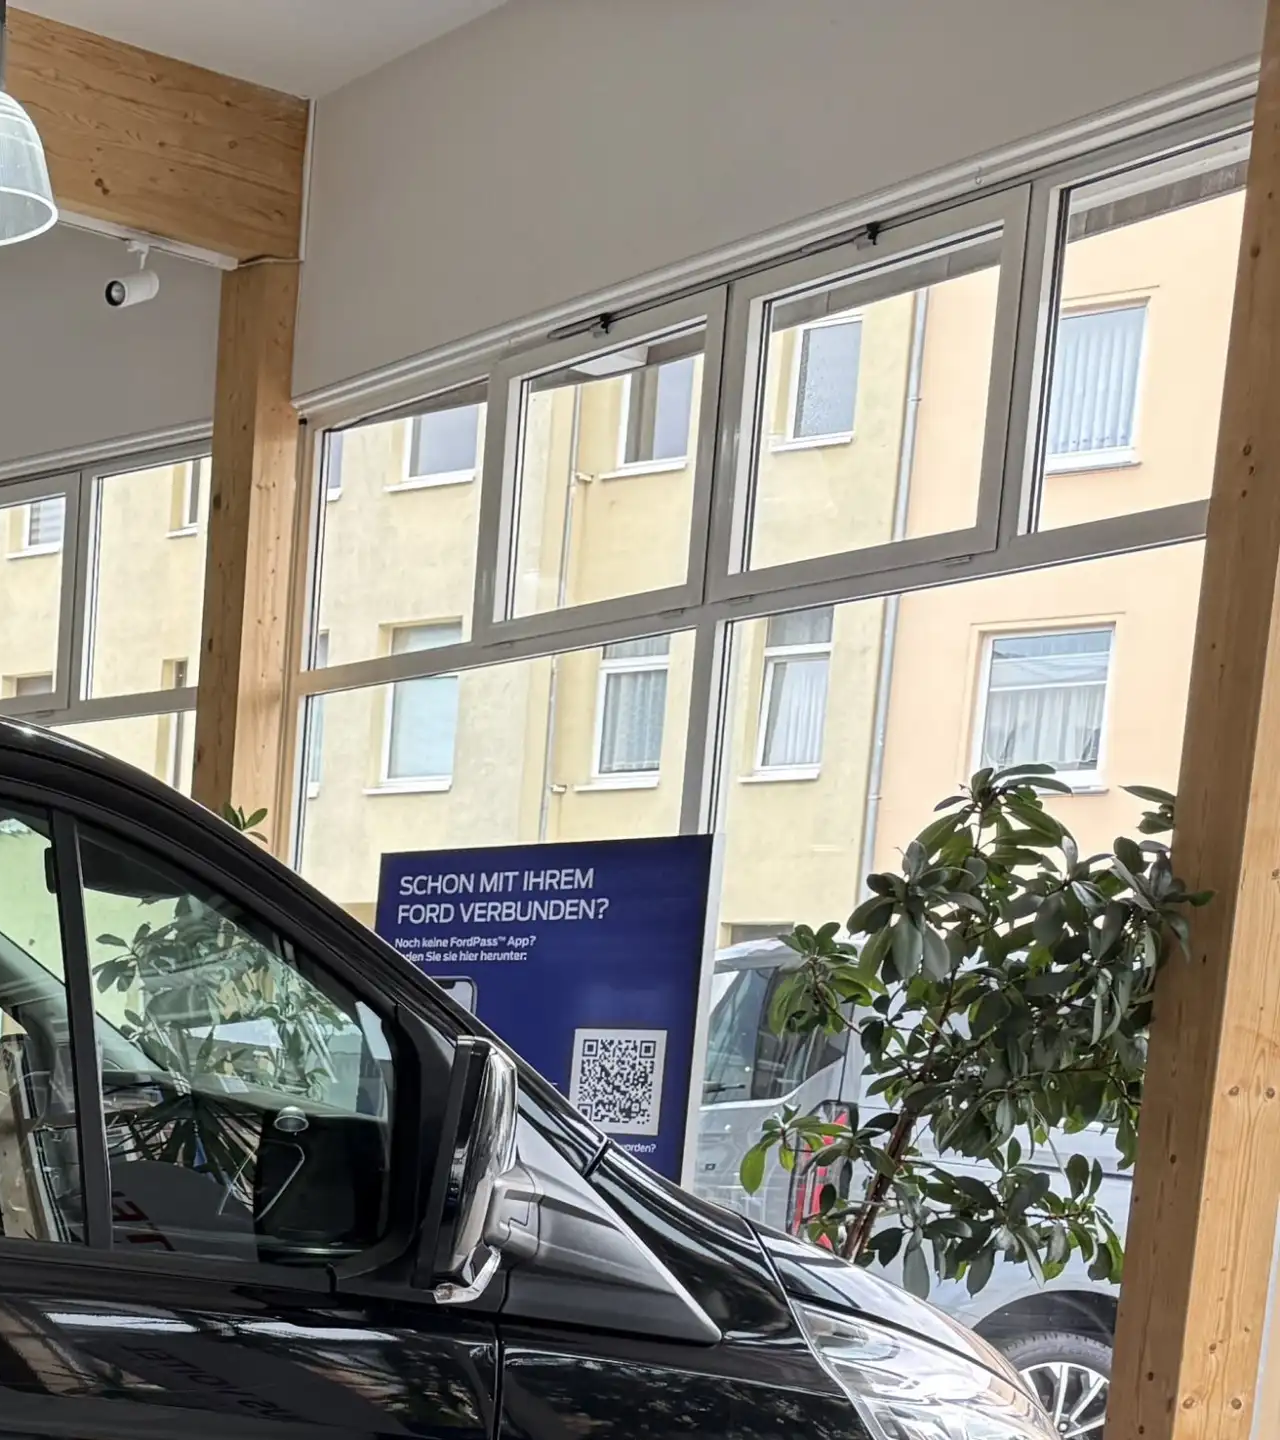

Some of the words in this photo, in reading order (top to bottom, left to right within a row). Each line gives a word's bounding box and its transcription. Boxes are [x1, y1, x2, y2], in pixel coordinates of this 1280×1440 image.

[399, 873, 474, 895] SCHON
[479, 871, 519, 893] MIT
[523, 868, 594, 891] IHREM
[397, 904, 454, 924] FORD
[460, 898, 609, 922] VERBUNDEN?
[395, 938, 420, 948] Noch
[422, 937, 448, 948] keine
[507, 935, 536, 948] App?
[425, 951, 441, 961] Sie
[443, 951, 458, 961] sie
[460, 950, 479, 961] hier
